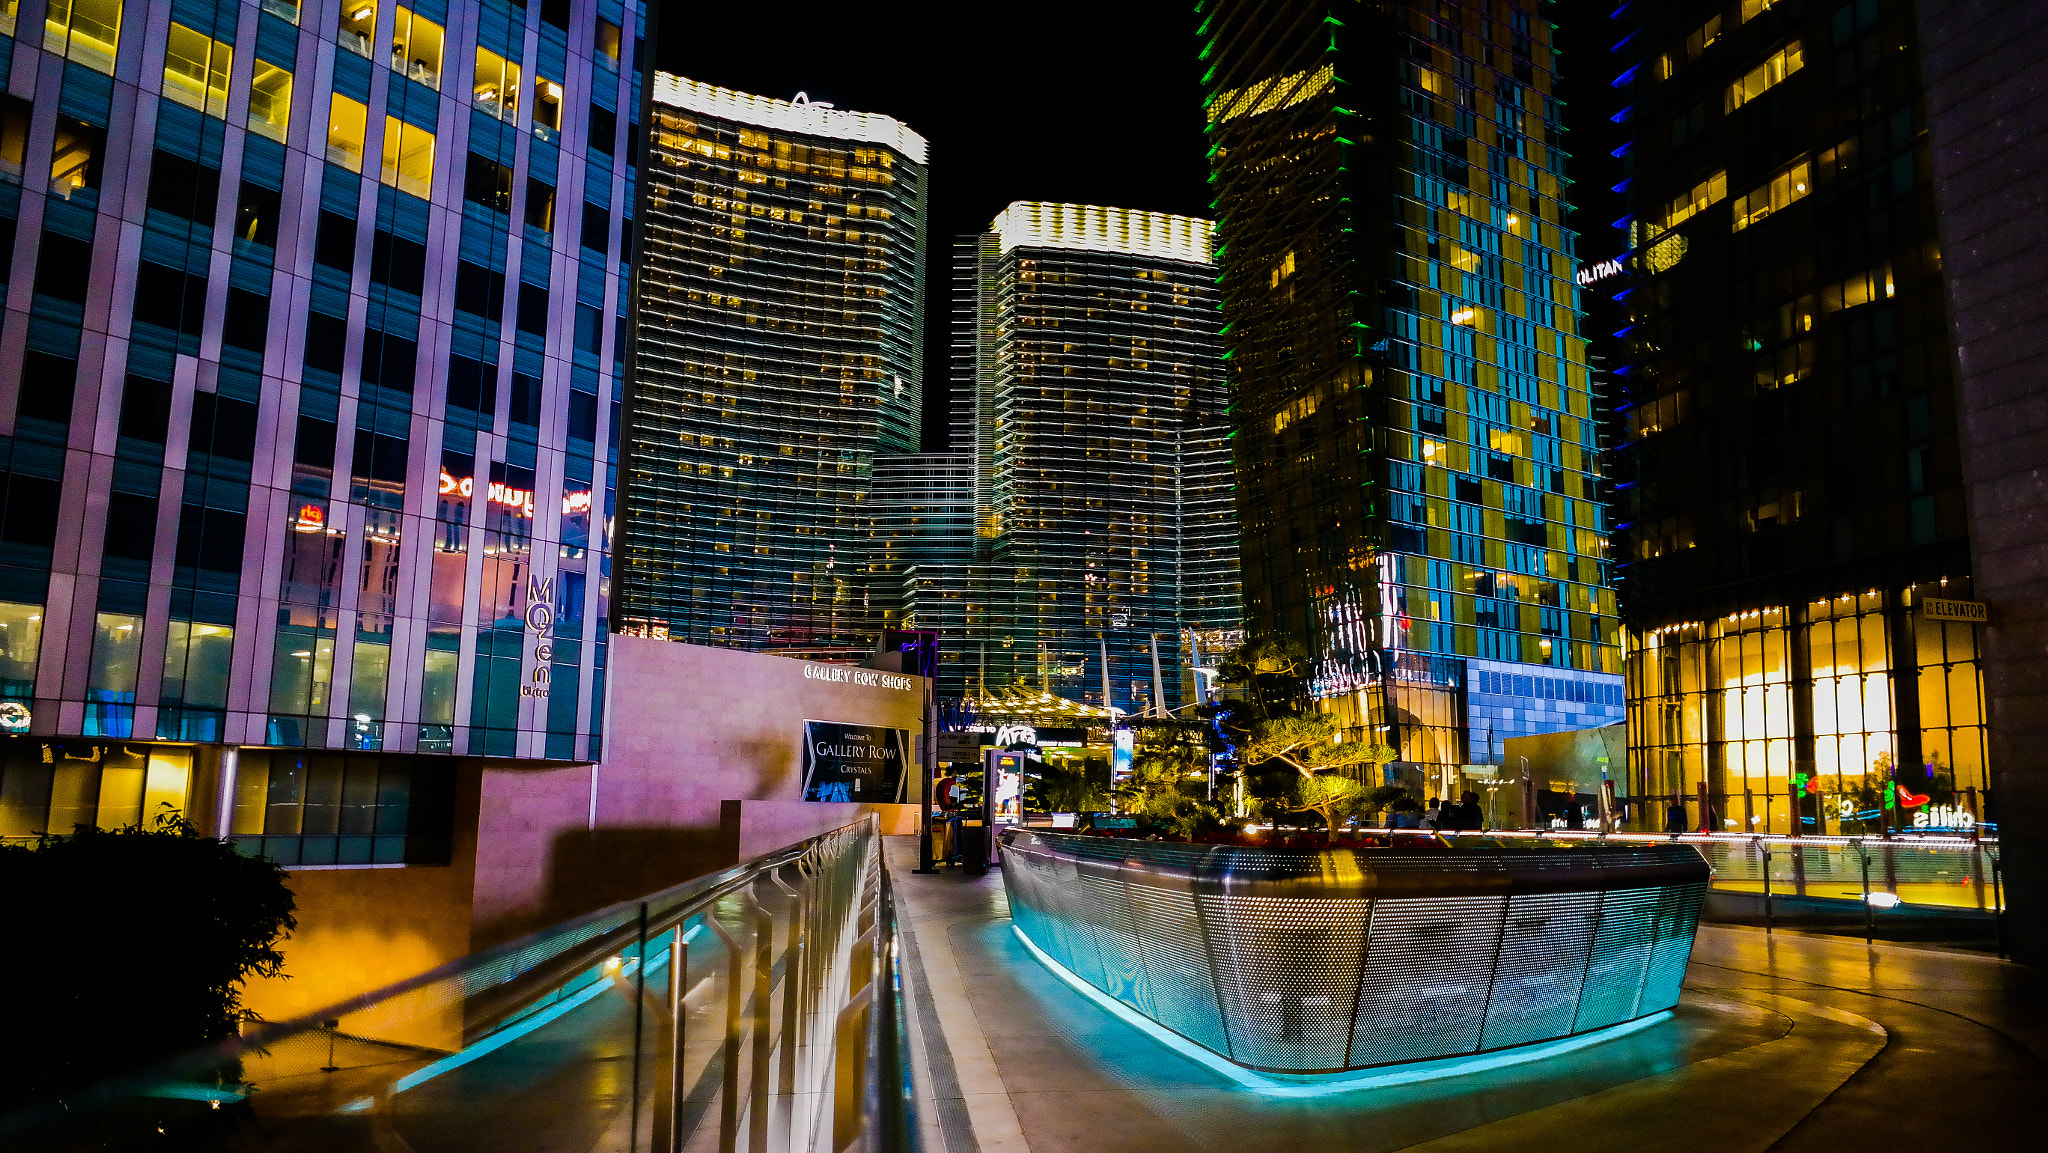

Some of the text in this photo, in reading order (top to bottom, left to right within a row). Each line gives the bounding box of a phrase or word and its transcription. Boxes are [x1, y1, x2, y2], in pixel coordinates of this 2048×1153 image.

[1934, 601, 1985, 619] ELEVATOR
[804, 664, 912, 691] GALLERY ROW SHOPS
[816, 741, 897, 760] GALLERY ROW
[840, 764, 872, 775] CRYSTALS
